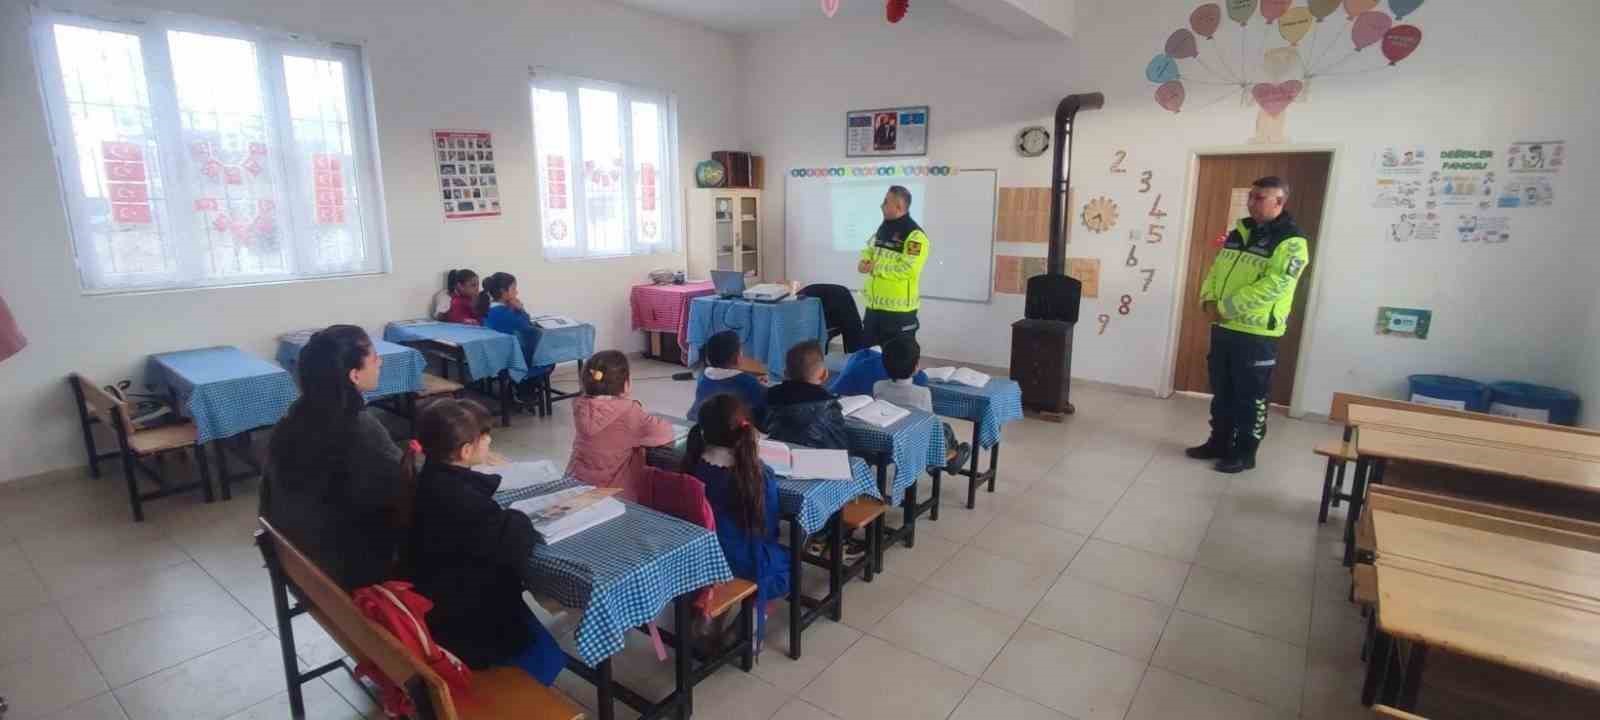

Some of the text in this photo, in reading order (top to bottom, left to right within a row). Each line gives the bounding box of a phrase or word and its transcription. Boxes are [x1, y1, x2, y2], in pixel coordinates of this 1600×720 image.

[1110, 150, 1127, 173] 2
[1138, 170, 1153, 193] 3
[1149, 193, 1168, 219] 4
[1146, 224, 1165, 244] 5
[1126, 244, 1139, 267] 6
[1140, 268, 1156, 293] 7
[1118, 294, 1132, 316] 8
[1097, 314, 1111, 335] 9
